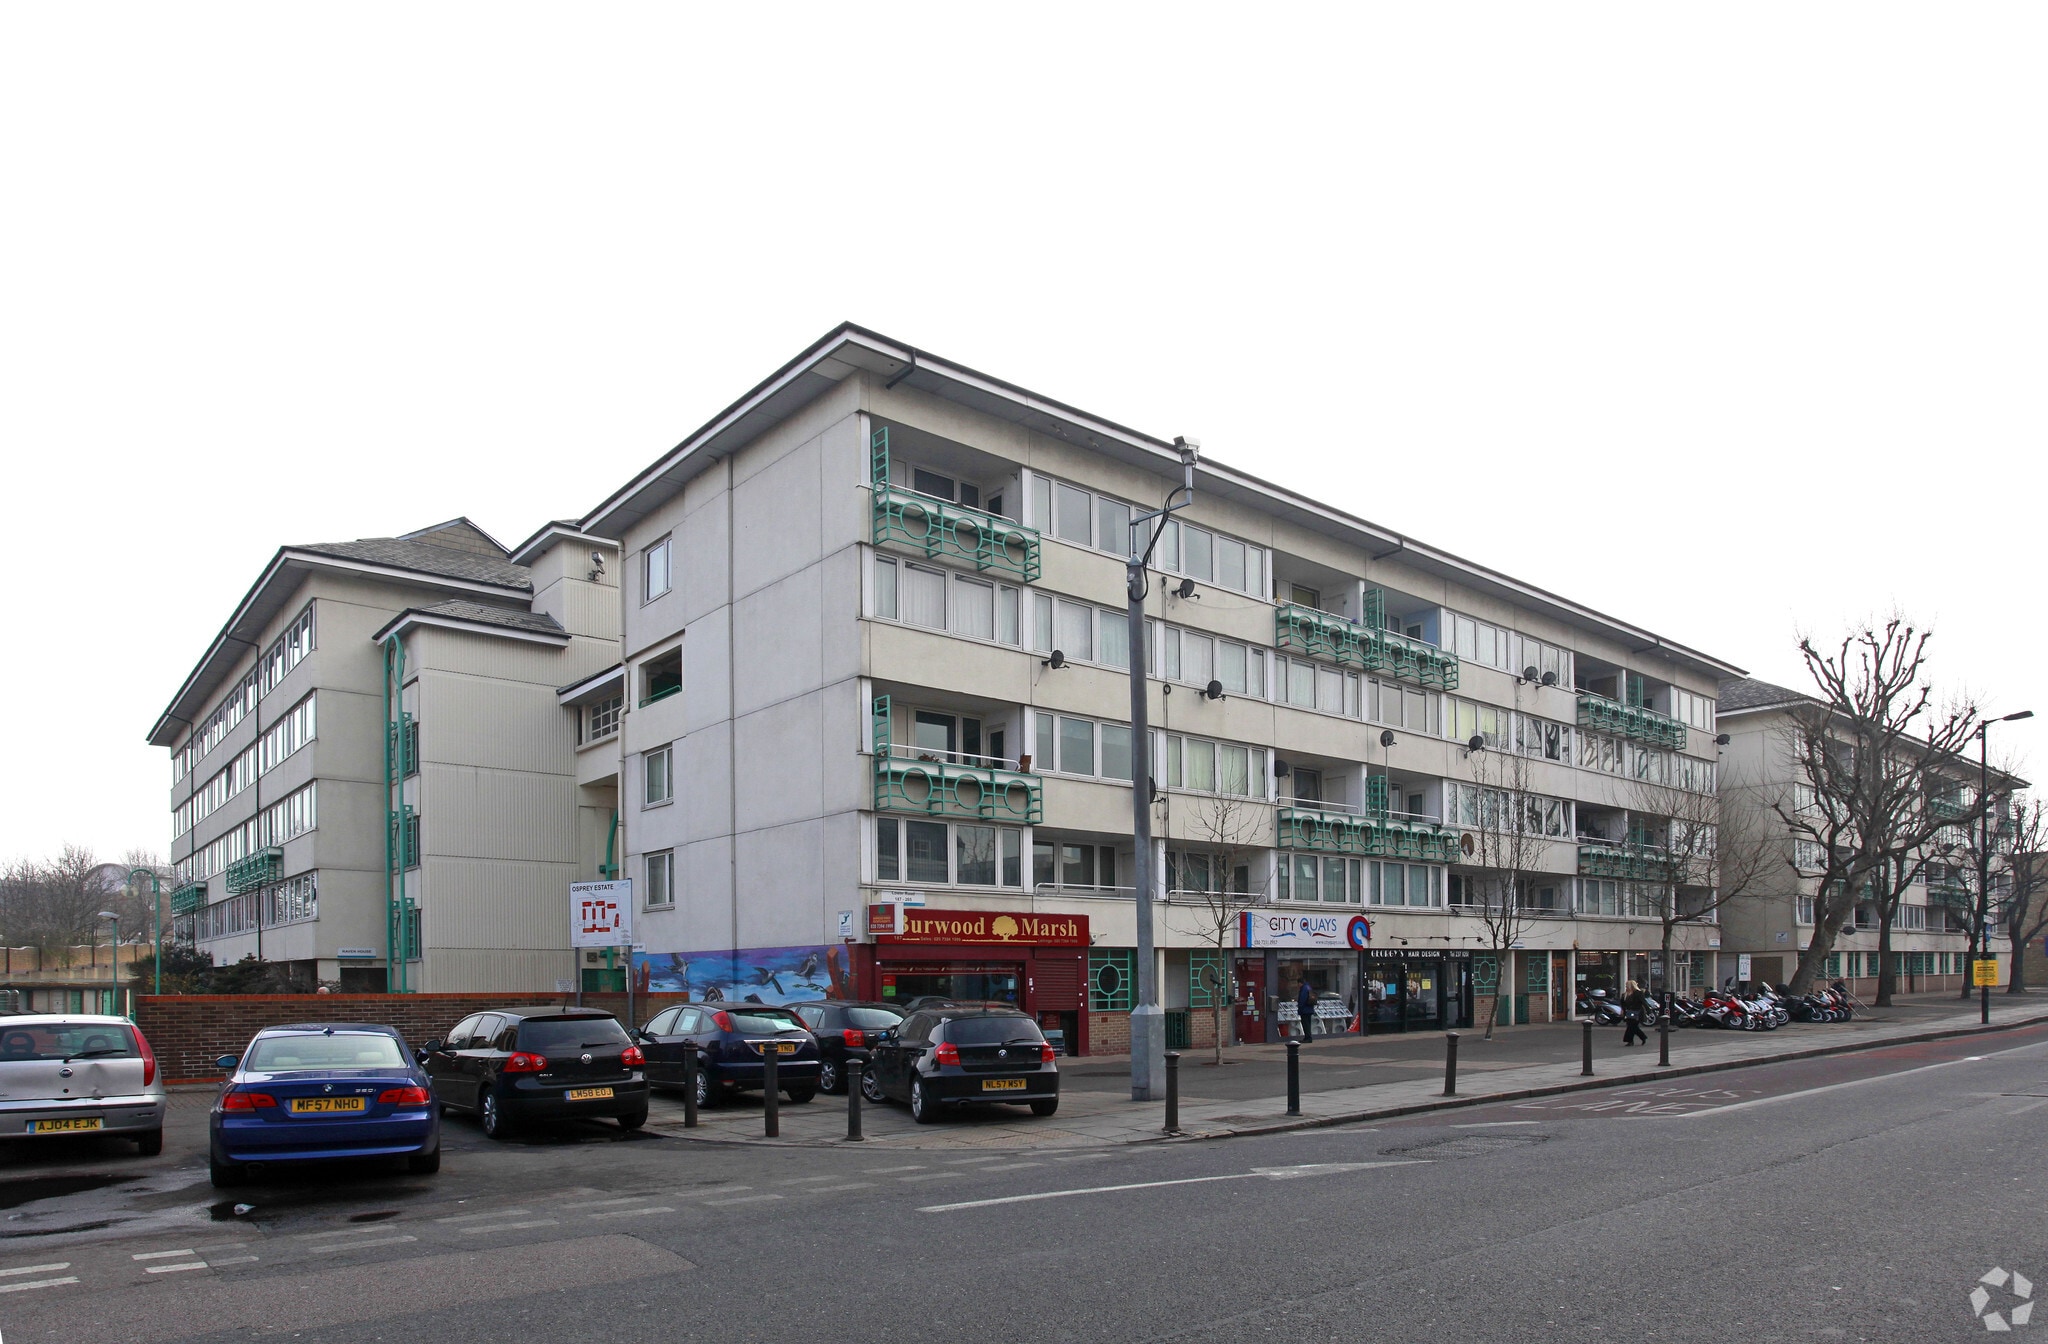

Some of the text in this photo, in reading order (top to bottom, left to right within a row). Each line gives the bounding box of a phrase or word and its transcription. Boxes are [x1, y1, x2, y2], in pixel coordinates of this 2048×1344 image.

[1021, 918, 1078, 936] Marsh
[1269, 917, 1337, 936] CITY QUAYS
[985, 1080, 1006, 1089] NL57
[571, 1087, 612, 1099] LM58 EOJ
[296, 1098, 359, 1111] MF57 NHO
[38, 1119, 98, 1131] AJ04 EJK
